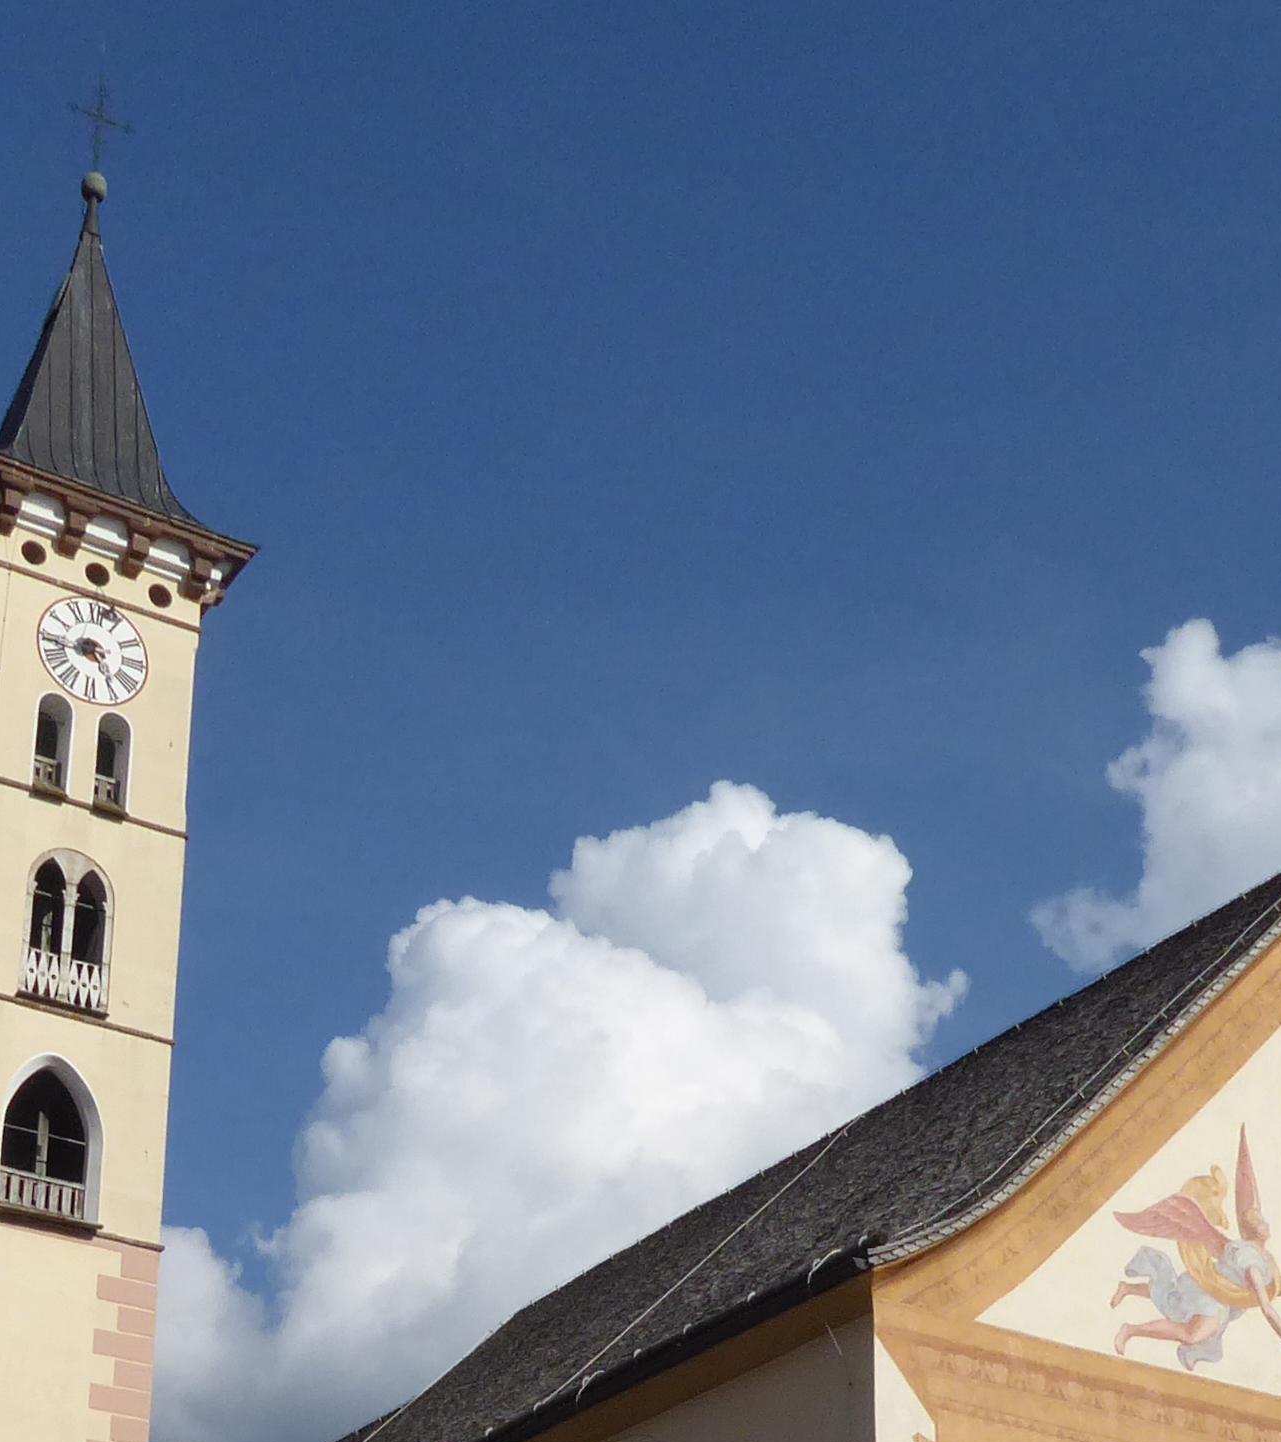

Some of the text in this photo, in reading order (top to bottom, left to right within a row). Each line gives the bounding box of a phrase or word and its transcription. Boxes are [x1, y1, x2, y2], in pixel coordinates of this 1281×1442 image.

[49, 610, 72, 632] X
[66, 601, 85, 624] XI
[118, 637, 141, 649] II
[121, 655, 144, 673] III
[58, 664, 80, 689] VII
[84, 676, 96, 700] VI
